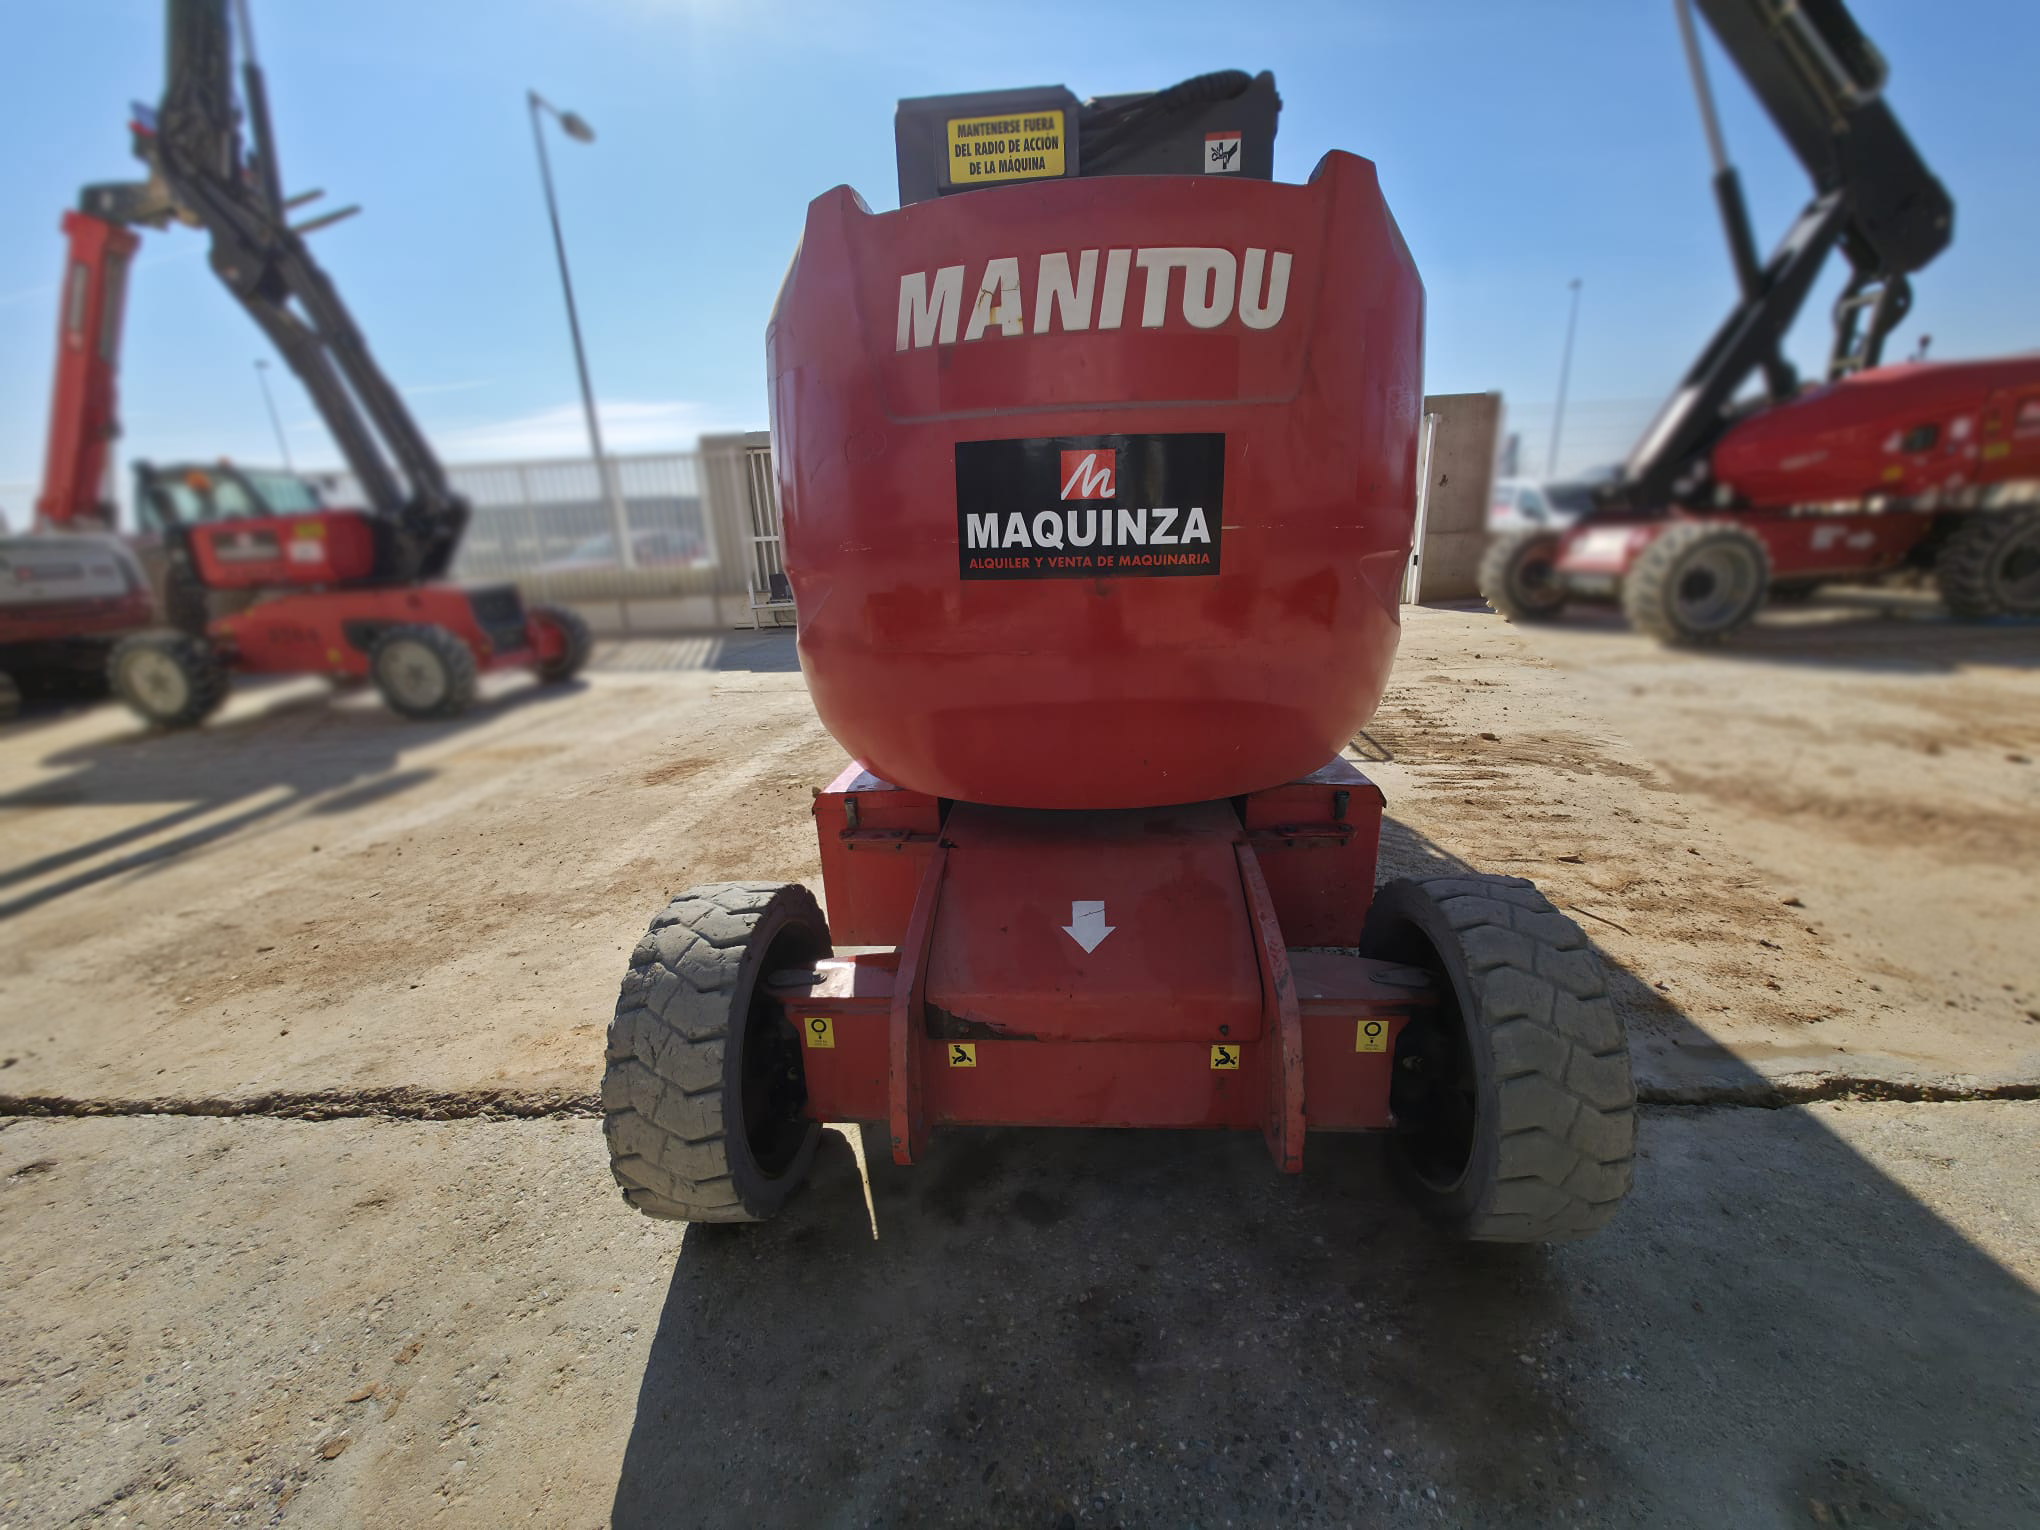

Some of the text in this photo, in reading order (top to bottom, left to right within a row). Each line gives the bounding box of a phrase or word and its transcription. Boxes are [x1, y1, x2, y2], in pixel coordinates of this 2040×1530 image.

[957, 117, 1055, 138] MANTENERSE FUERA
[954, 132, 1059, 157] DEL RADIO DE ACCIÓN
[969, 154, 1046, 175] DE LA MÁQUINA
[896, 247, 1293, 352] MANITOU
[966, 507, 1211, 550] MAQUINZA
[969, 553, 1210, 569] ALQUILER Y VENTA DE MAQUINARIA
